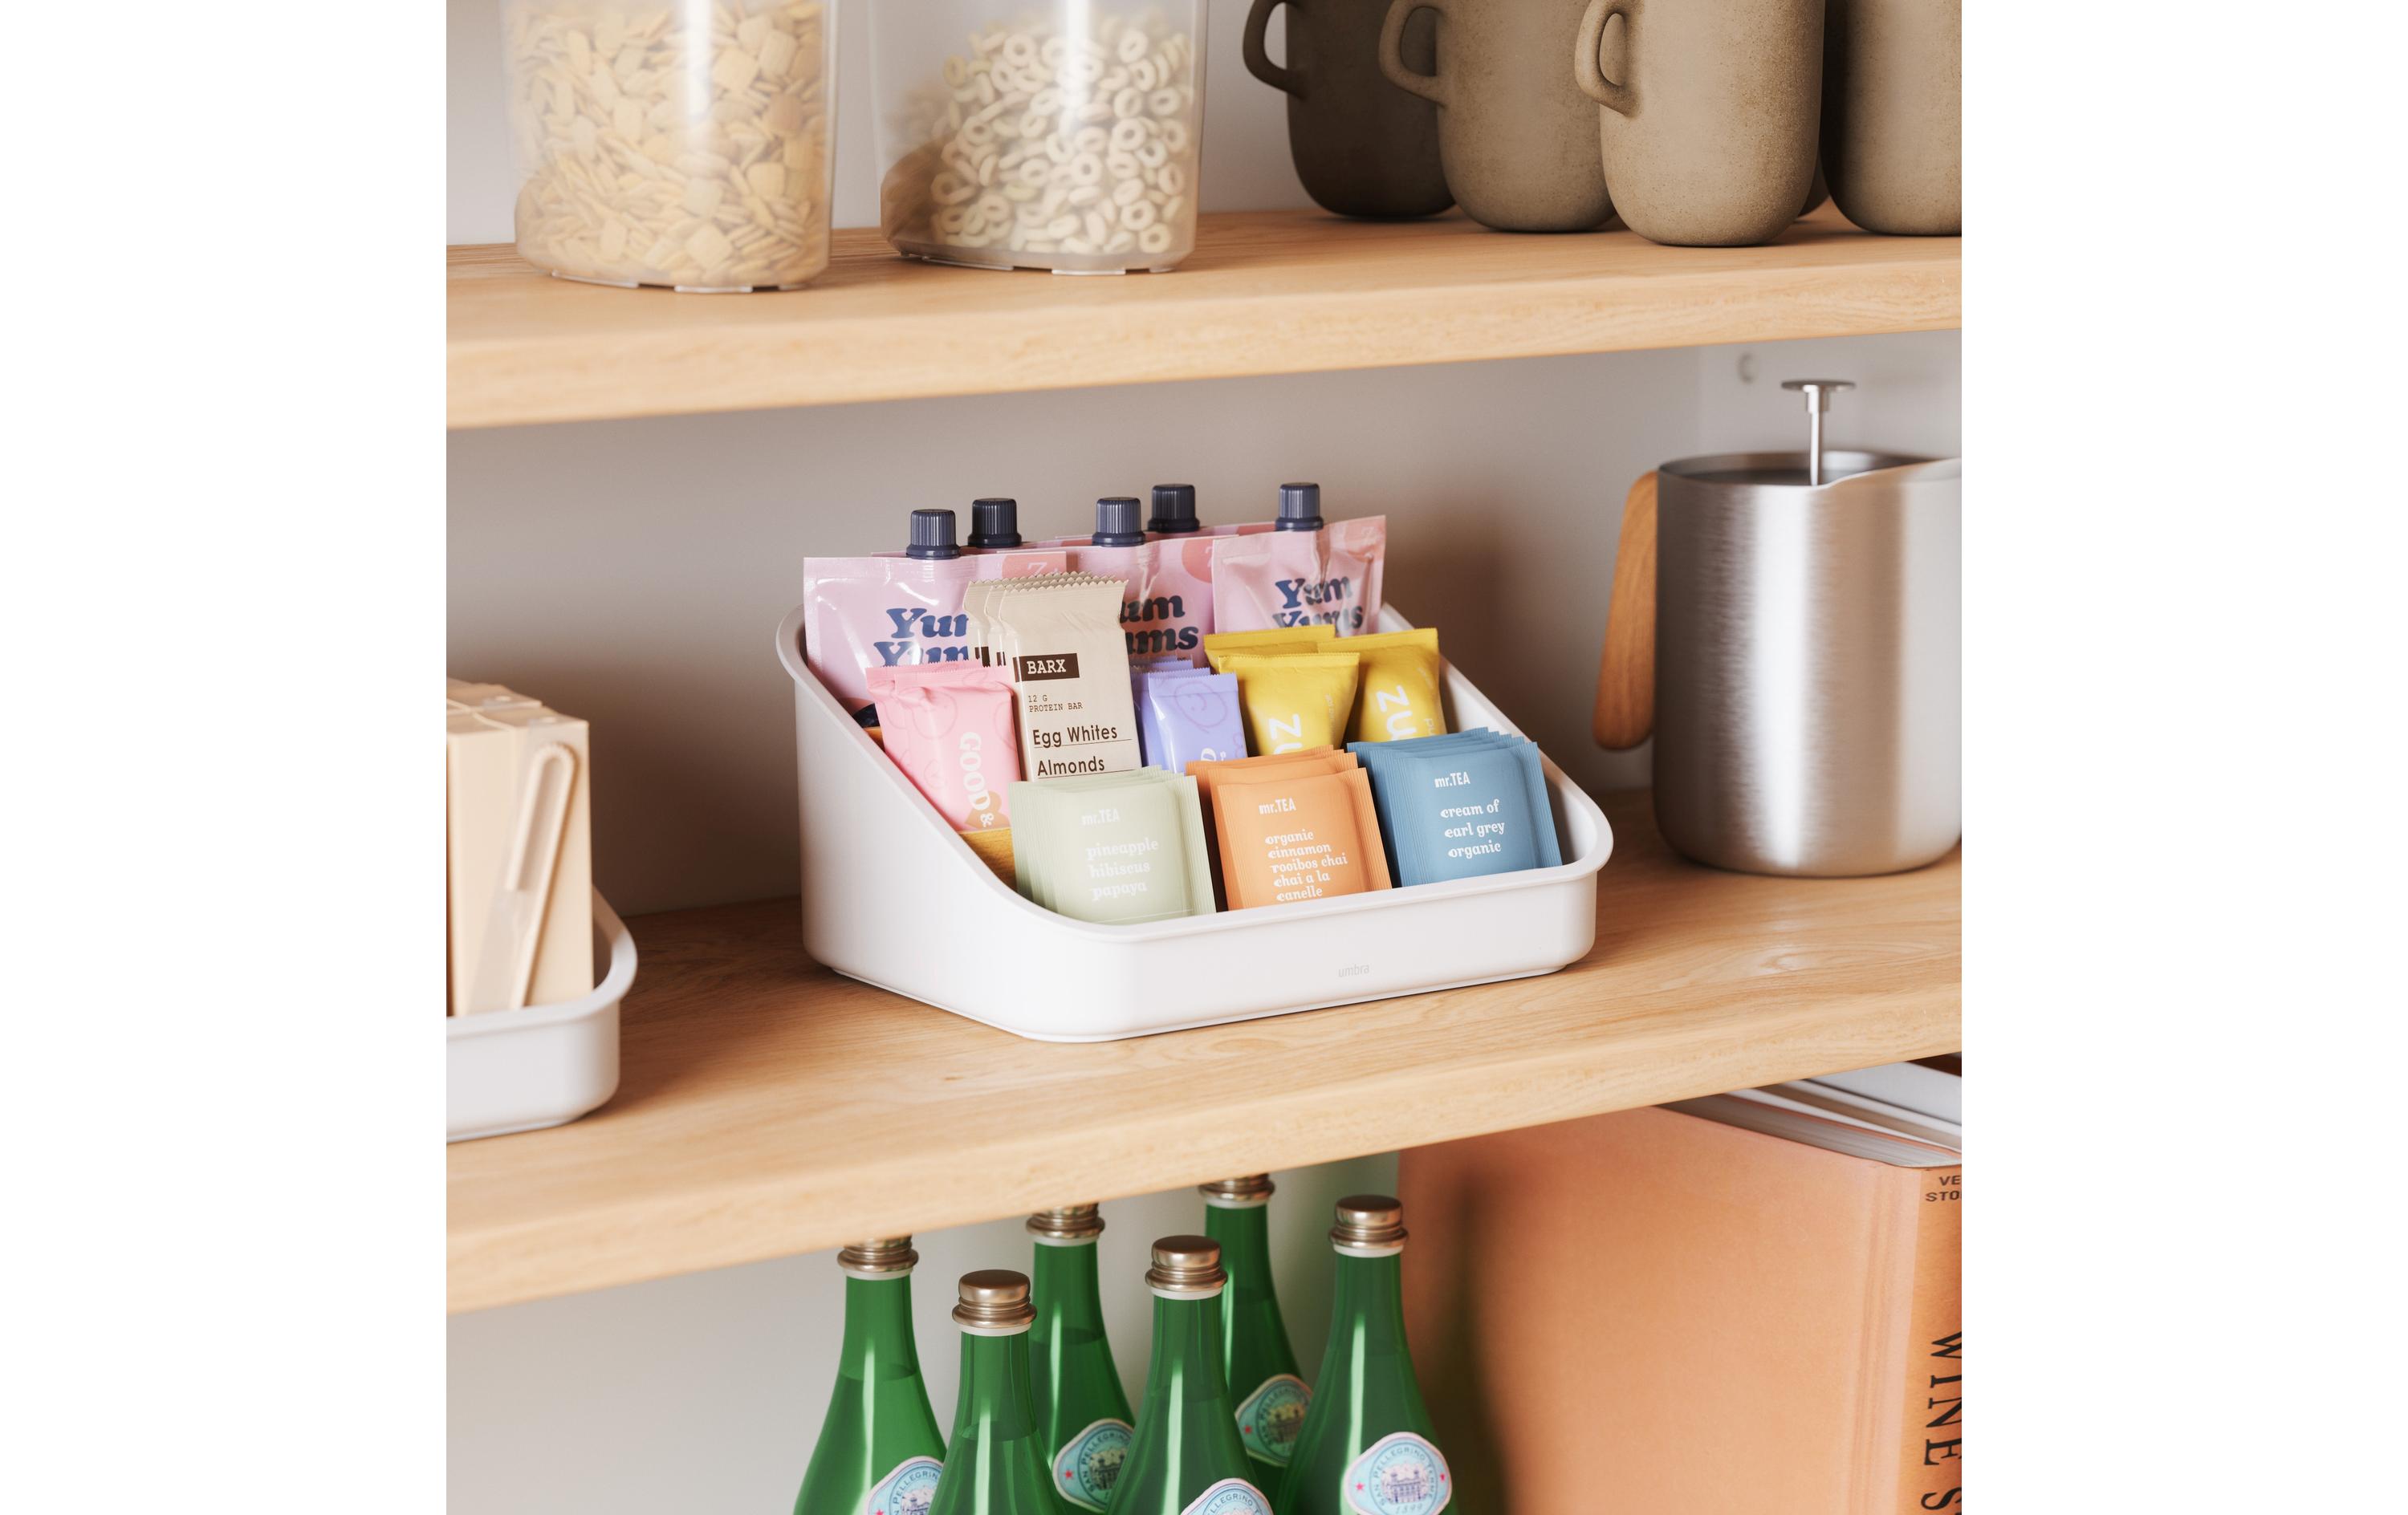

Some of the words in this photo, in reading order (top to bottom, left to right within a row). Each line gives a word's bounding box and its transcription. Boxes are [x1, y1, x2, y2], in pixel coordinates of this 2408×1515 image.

[1275, 576, 1353, 609] Yum
[1120, 595, 1186, 623] um
[1125, 626, 1199, 656] ms
[1027, 659, 1067, 675] BARX
[1028, 695, 1038, 703] 12
[1042, 694, 1048, 702] G
[1029, 703, 1064, 713] PROTEIN
[1068, 701, 1084, 710] BAR
[1033, 729, 1062, 748] Egg
[1067, 725, 1117, 742] Whites
[959, 731, 991, 810] GOOD
[1037, 756, 1105, 776] Almonds
[1434, 771, 1470, 788] mr.TEA
[1259, 798, 1296, 814] mr.TEA
[1440, 805, 1483, 818] cream
[1487, 798, 1499, 813] of
[1081, 808, 1120, 826] mr.TEA
[1265, 829, 1314, 846] organic
[1444, 822, 1474, 838] earl
[1477, 822, 1505, 838] grey
[1085, 837, 1159, 860] pineapple
[1267, 843, 1332, 859] cinnamon
[1448, 839, 1501, 859] organic
[1087, 862, 1150, 879] hibiscus
[1271, 859, 1318, 873] rooibos
[1321, 852, 1348, 867] chai
[1274, 872, 1303, 887] chai
[1306, 875, 1314, 883] a
[1316, 870, 1330, 882] la
[1088, 882, 1148, 902] papaya
[1276, 886, 1323, 901] canelle
[1338, 963, 1370, 977] umbra
[1926, 1191, 1961, 1202] STO
[1924, 1331, 1962, 1465] WINE
[893, 1470, 939, 1505] PELLEGRIN
[1208, 1493, 1253, 1515] LLEGRINO
